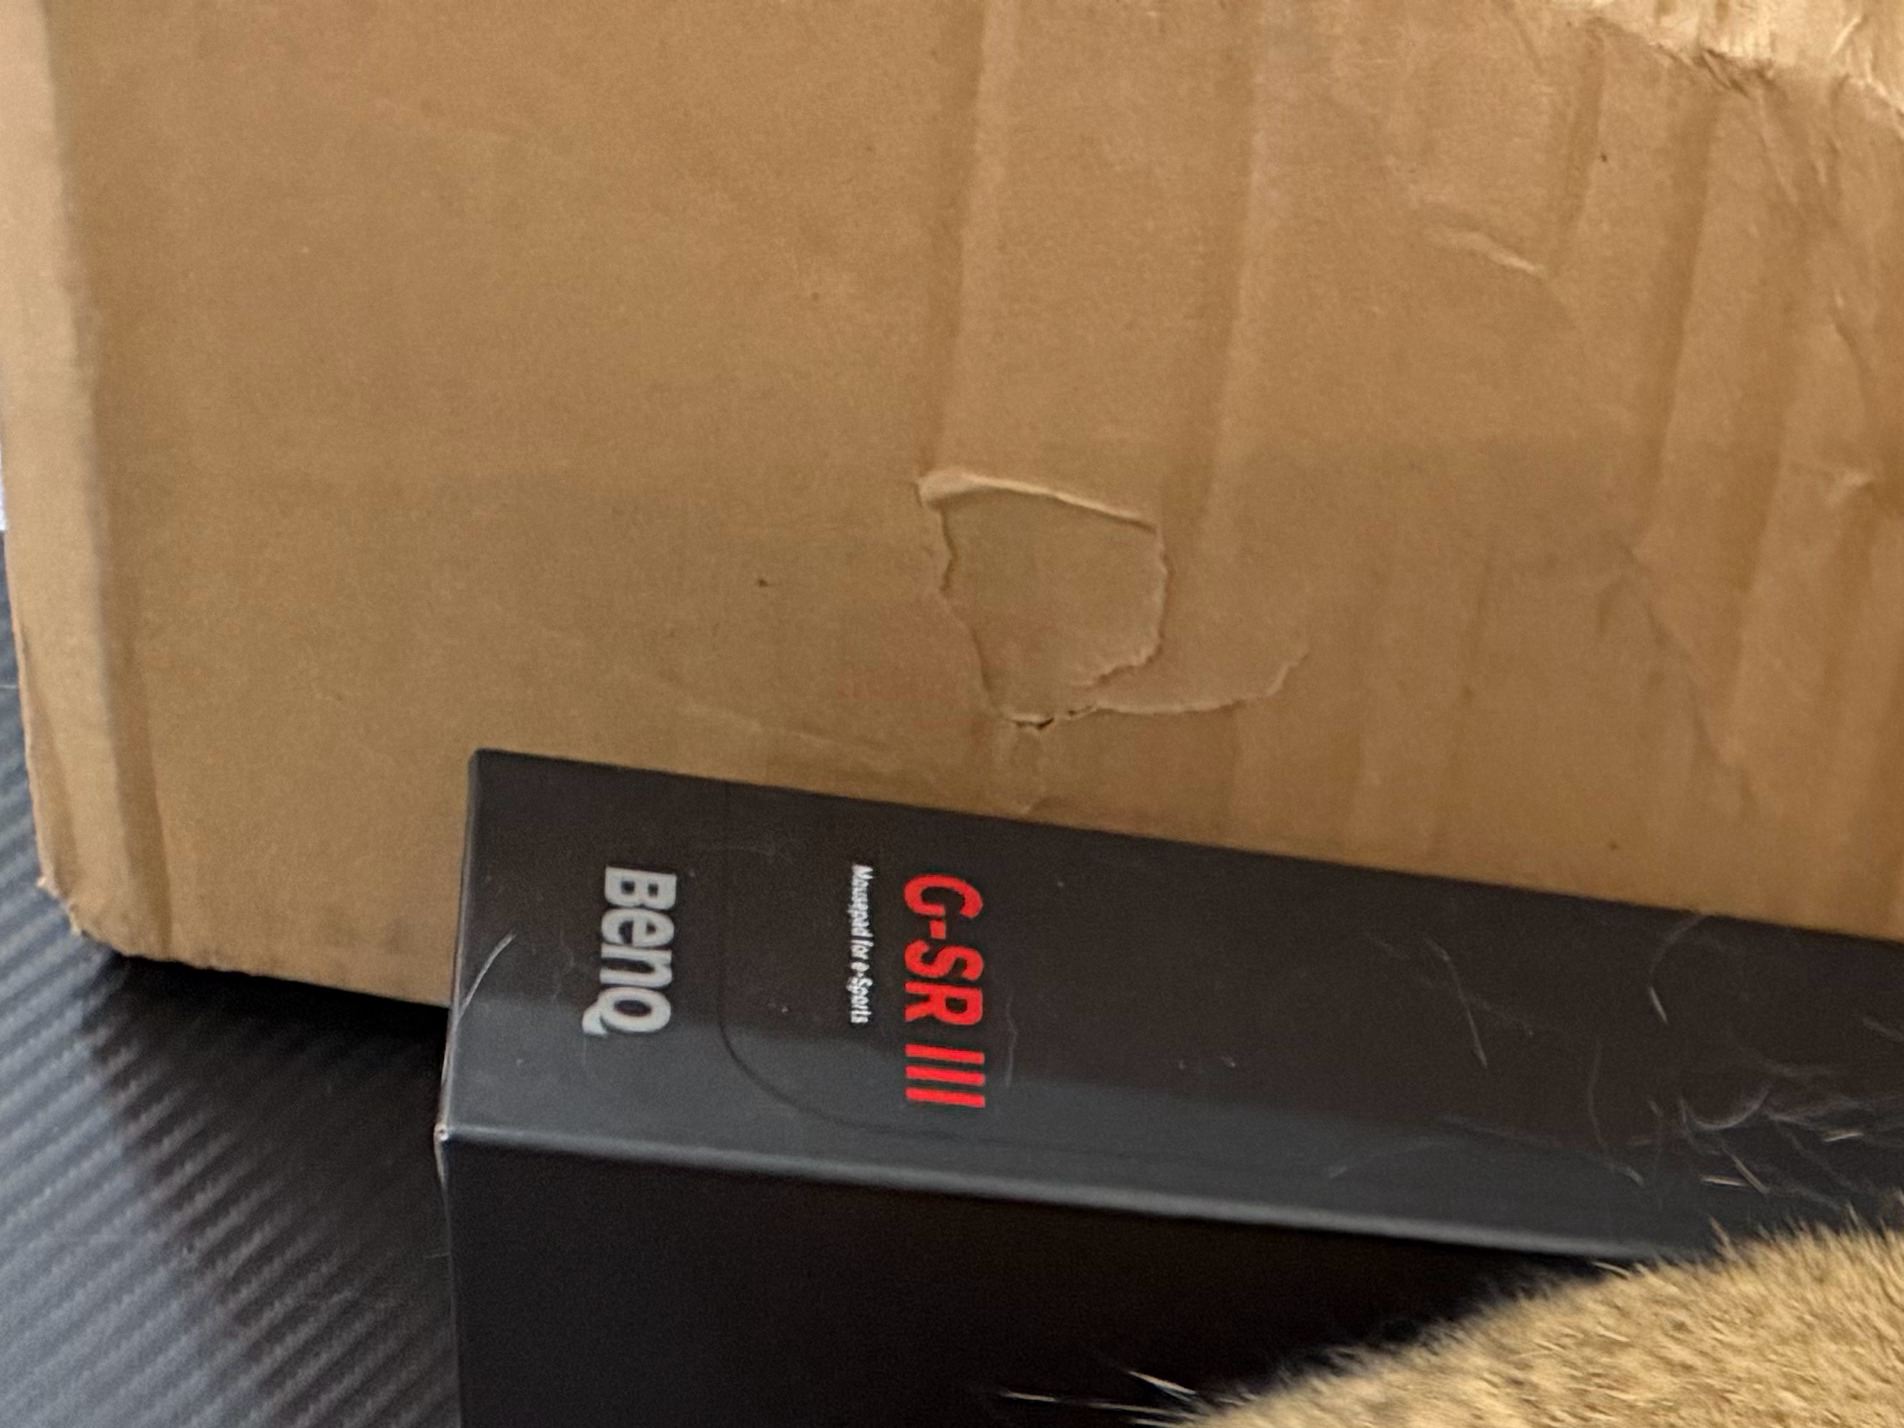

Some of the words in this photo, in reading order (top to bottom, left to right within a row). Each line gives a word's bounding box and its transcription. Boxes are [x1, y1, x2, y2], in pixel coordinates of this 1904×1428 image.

[582, 866, 677, 1036] BenQ
[903, 873, 984, 1026] G-SR
[904, 1043, 985, 1107] III
